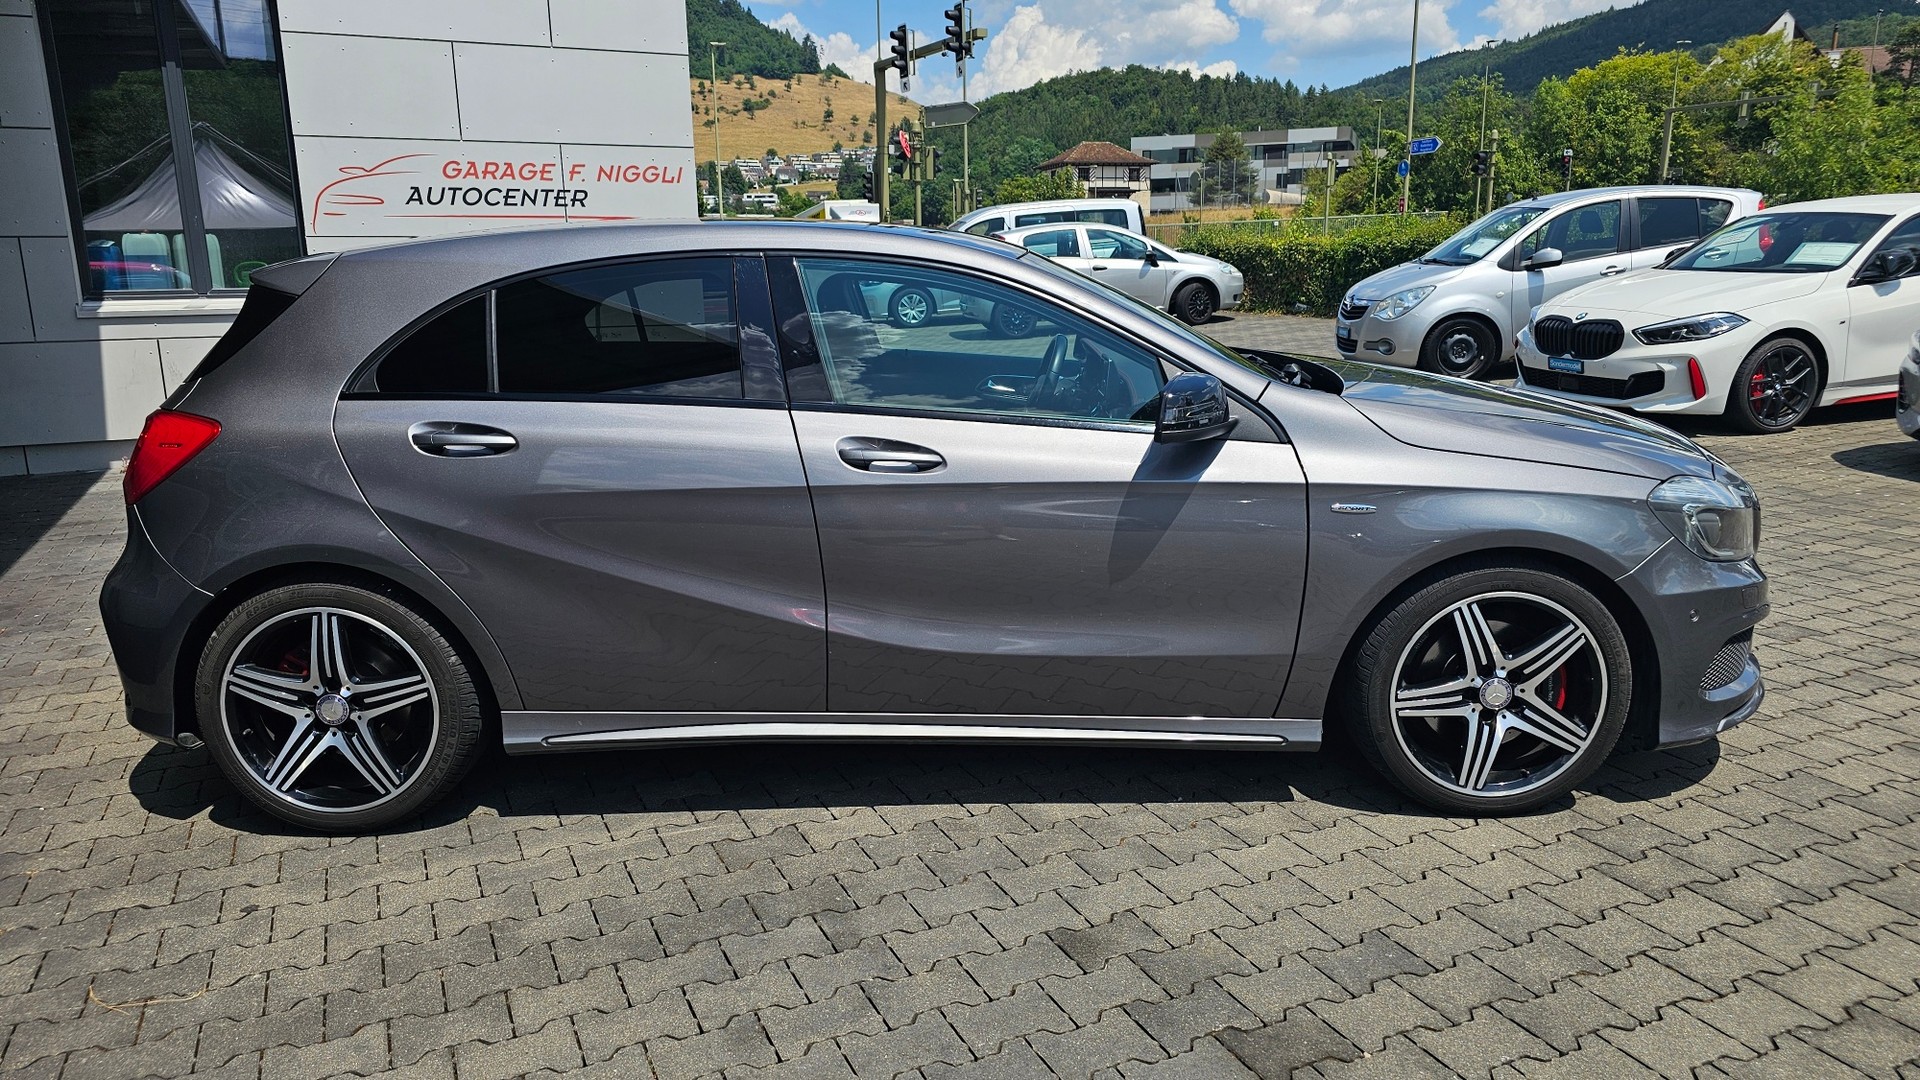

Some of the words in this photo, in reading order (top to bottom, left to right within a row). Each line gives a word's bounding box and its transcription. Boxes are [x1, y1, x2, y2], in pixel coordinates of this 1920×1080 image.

[442, 160, 556, 181] GARAGE
[568, 164, 586, 183] F.
[597, 164, 683, 184] NIGGLI
[405, 186, 588, 208] AUTOCENTER
